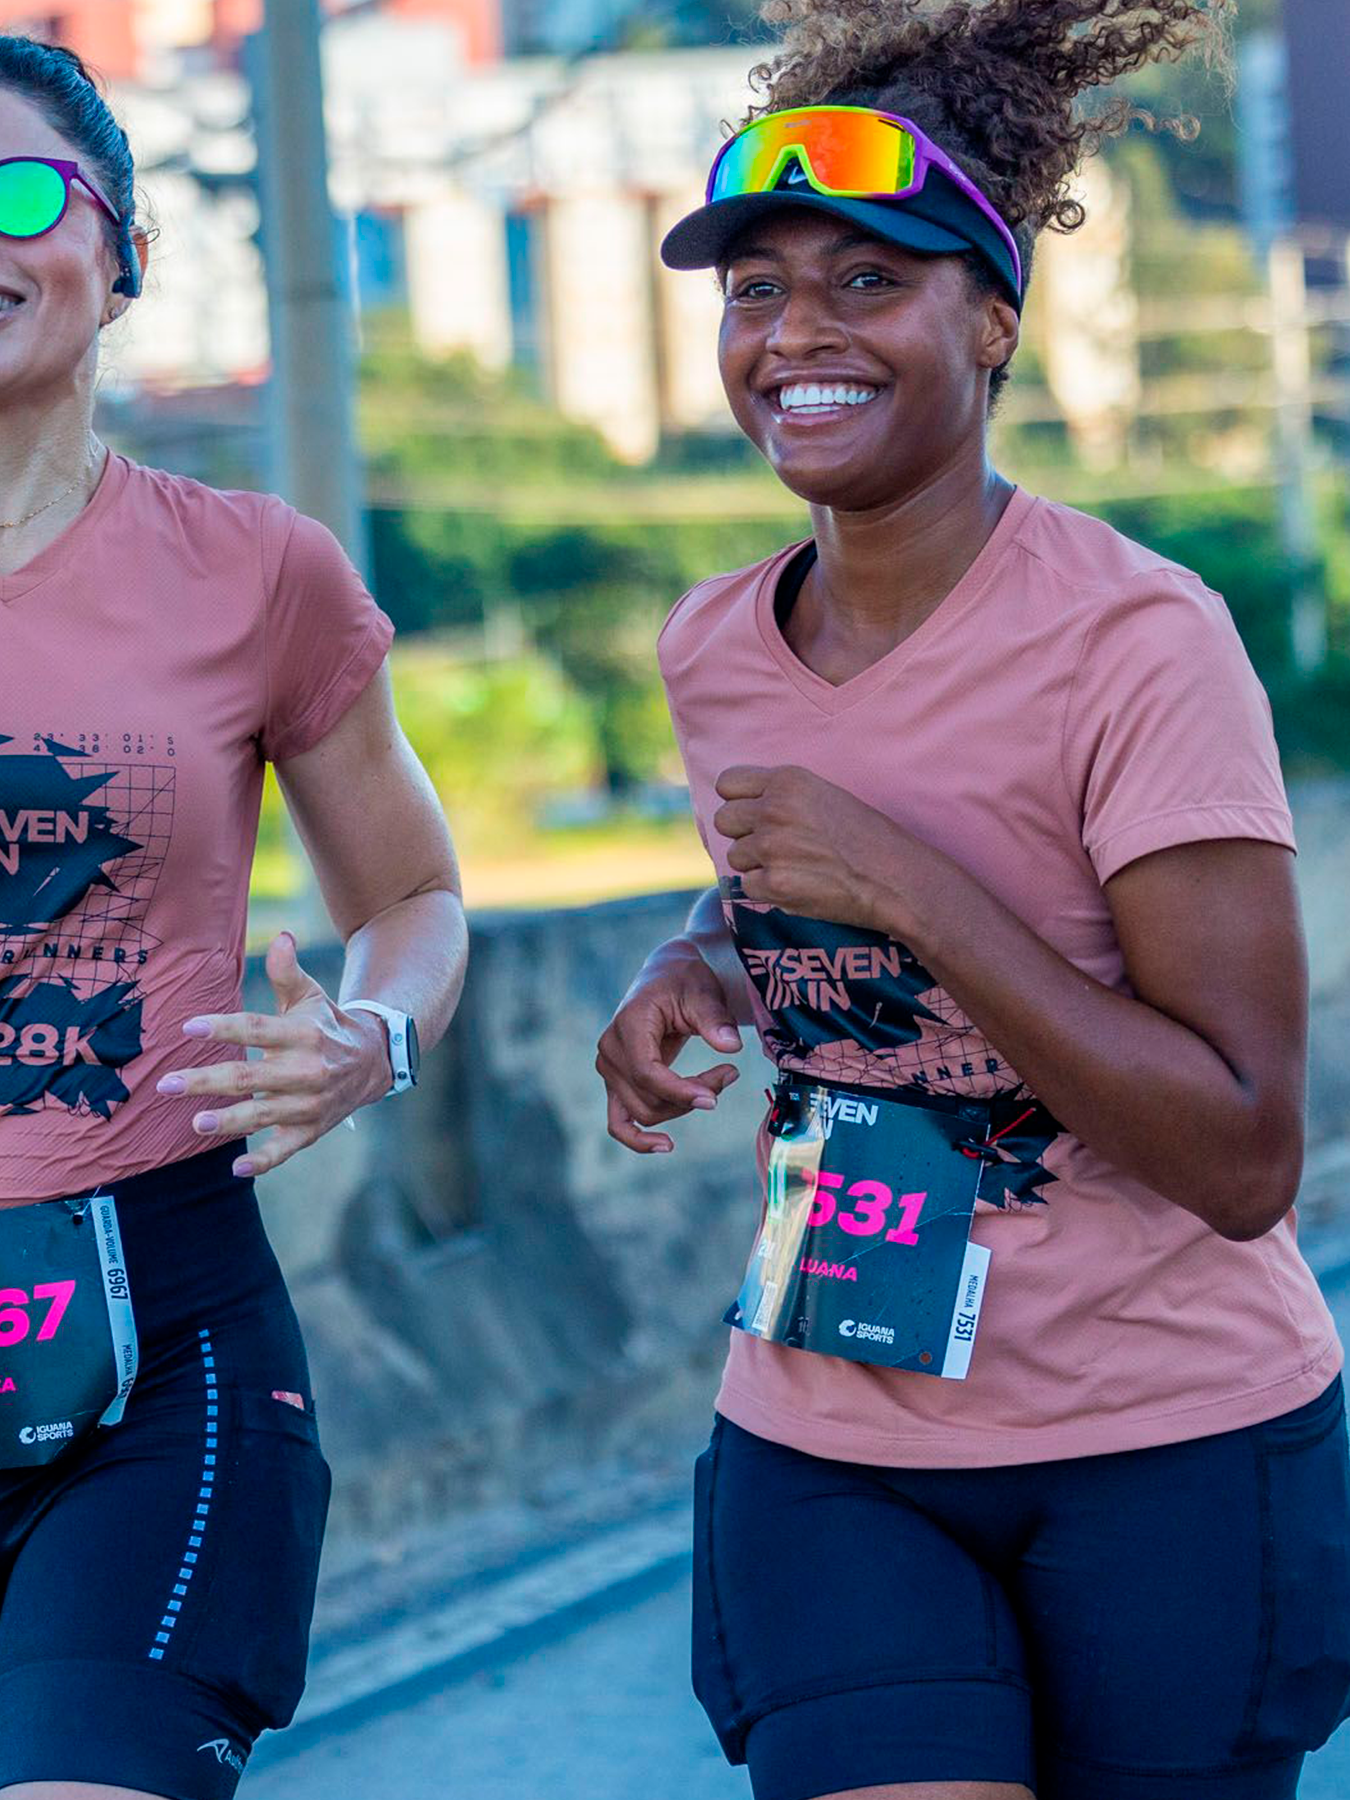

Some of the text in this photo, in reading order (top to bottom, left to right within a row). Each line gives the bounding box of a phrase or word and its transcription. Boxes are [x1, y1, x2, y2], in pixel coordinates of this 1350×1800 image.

[1, 942, 149, 966] RNNERS
[779, 946, 902, 982] SEVEN
[804, 1168, 928, 1247] 531
[107, 1268, 129, 1300] 6967
[954, 1274, 979, 1342] MEDALHA 7531
[856, 1330, 894, 1345] SPORTS
[857, 1321, 895, 1337] IGUANA
[36, 1421, 74, 1434] IGUANA
[37, 1429, 74, 1442] SPORTS
